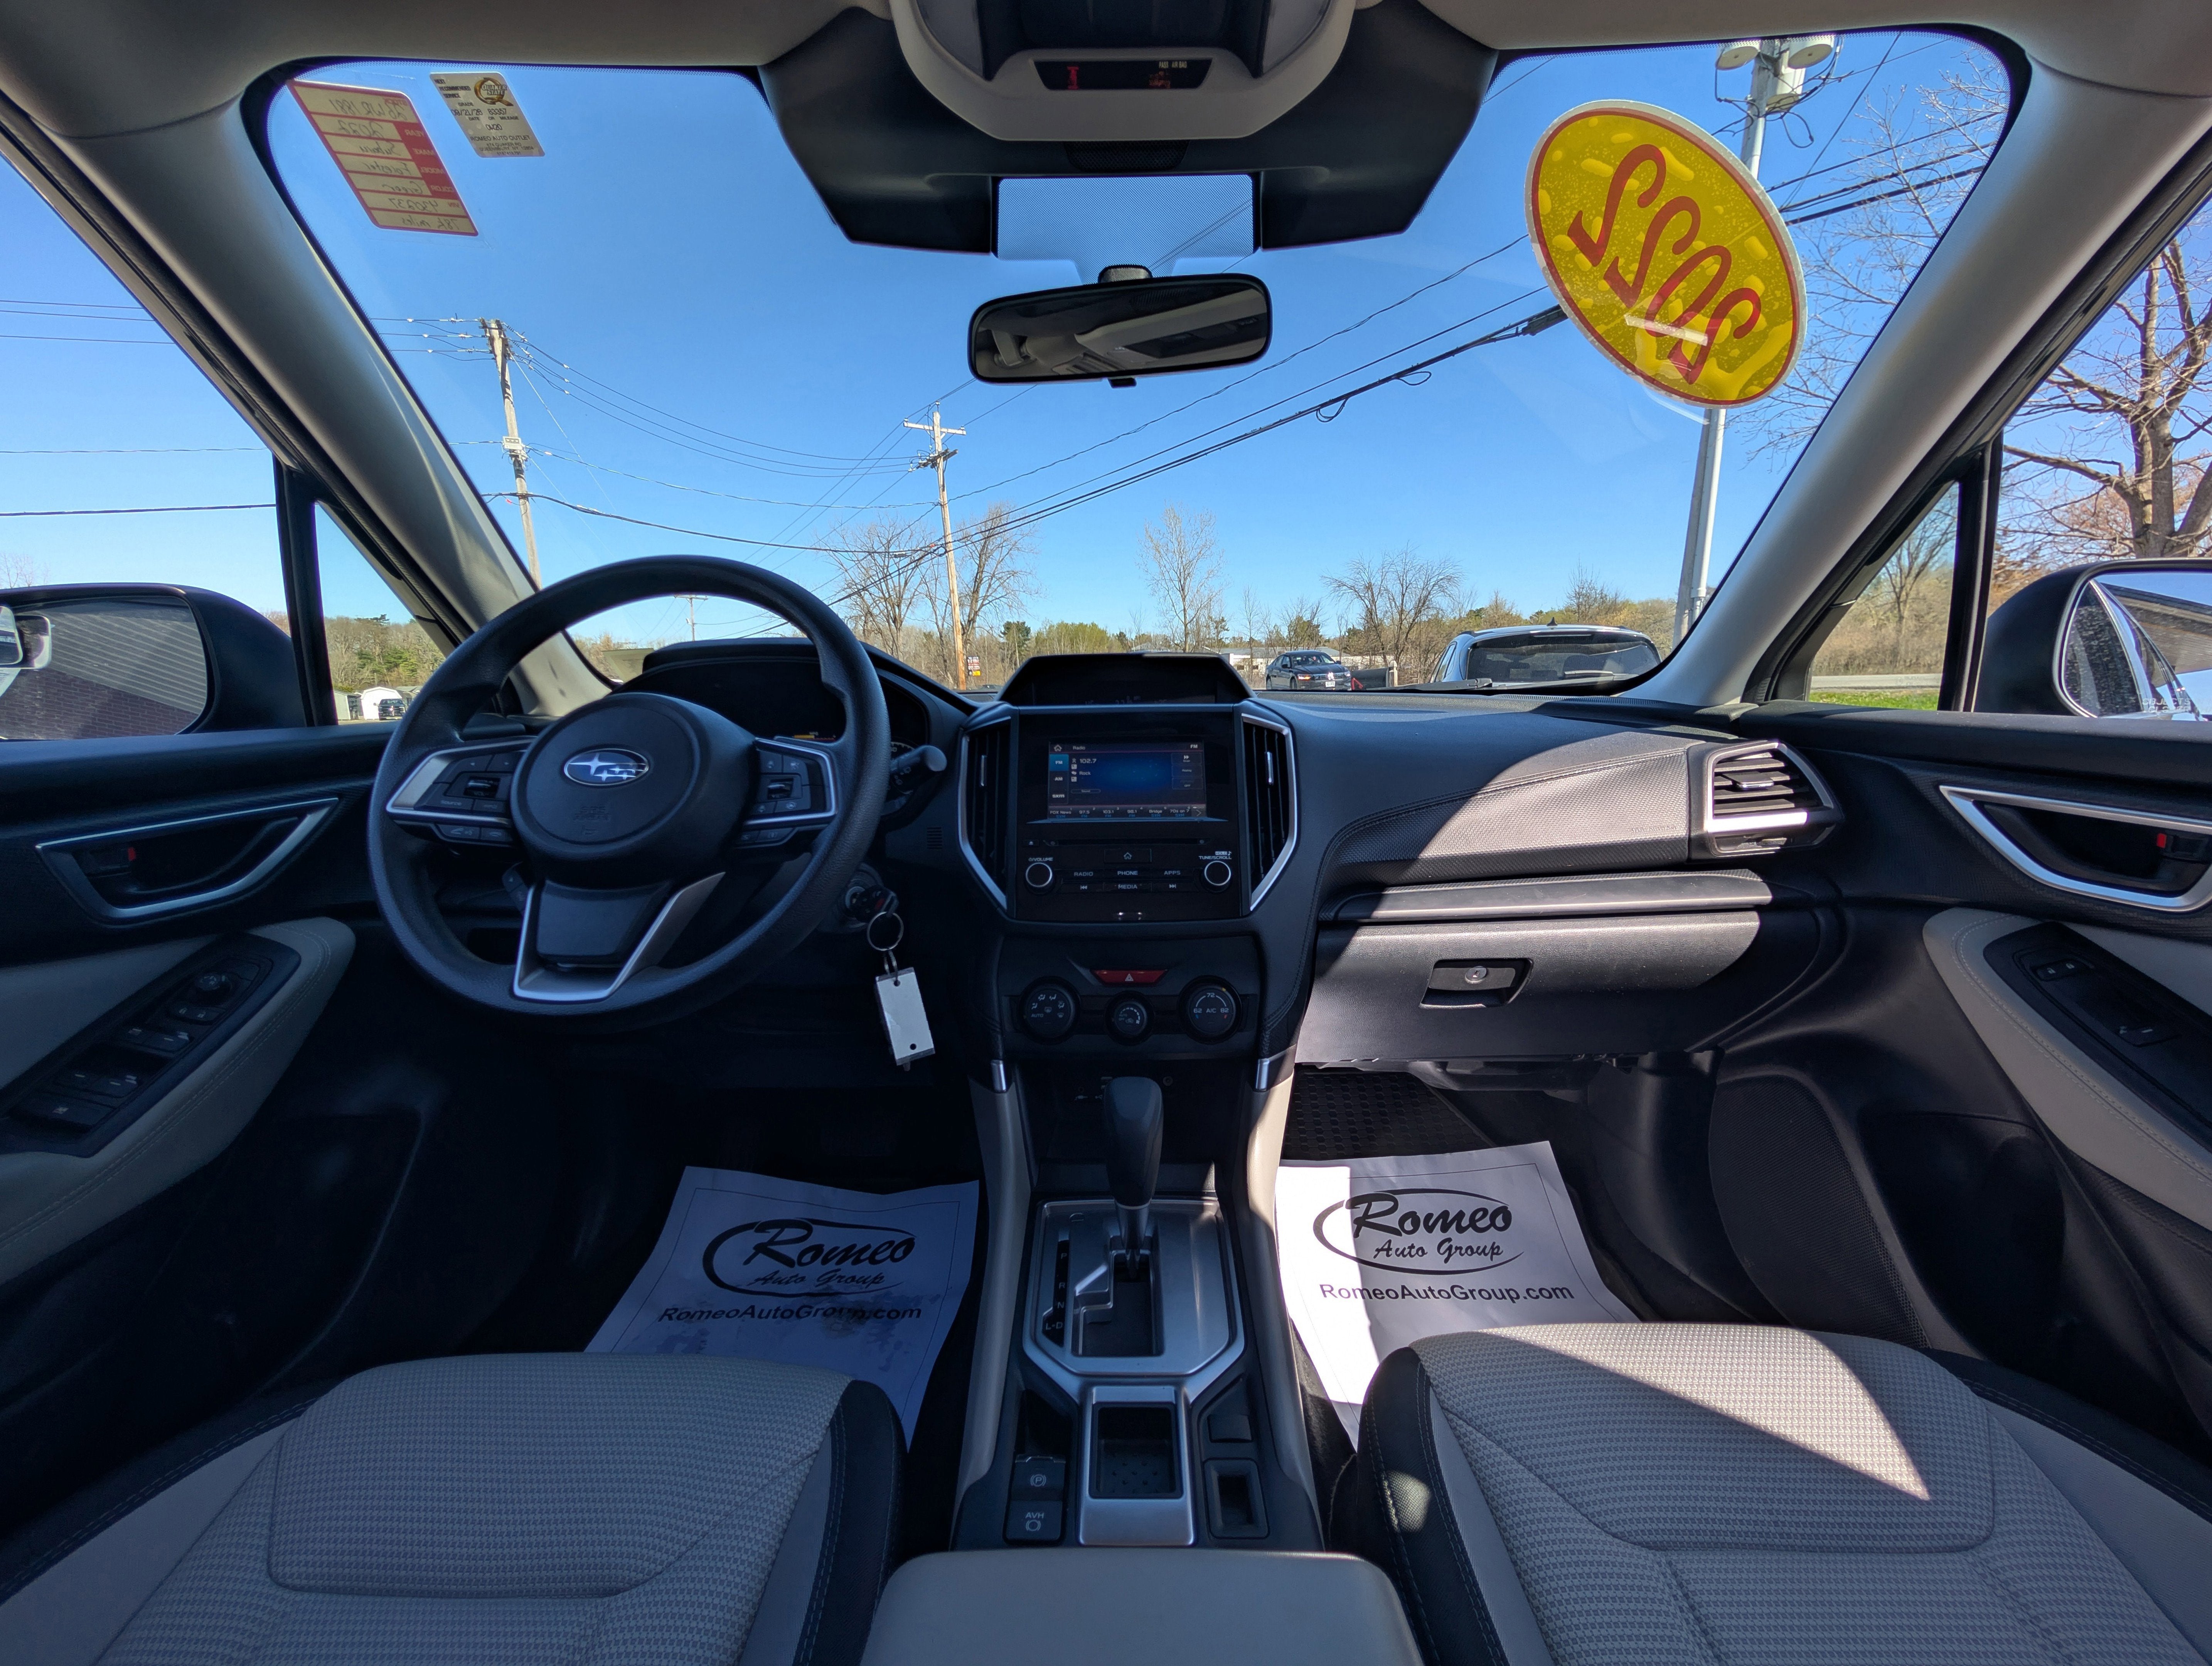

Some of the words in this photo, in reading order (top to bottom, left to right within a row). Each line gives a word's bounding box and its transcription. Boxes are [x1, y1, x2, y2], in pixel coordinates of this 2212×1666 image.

[1345, 1192, 1512, 1238] Romeo
[743, 1219, 915, 1268] Romeo
[1373, 1239, 1428, 1259] Auto
[1437, 1237, 1503, 1264] Group
[748, 1270, 806, 1286] Auto
[816, 1268, 885, 1287] Group
[1319, 1284, 1574, 1303] RomeoAutoGroup.com
